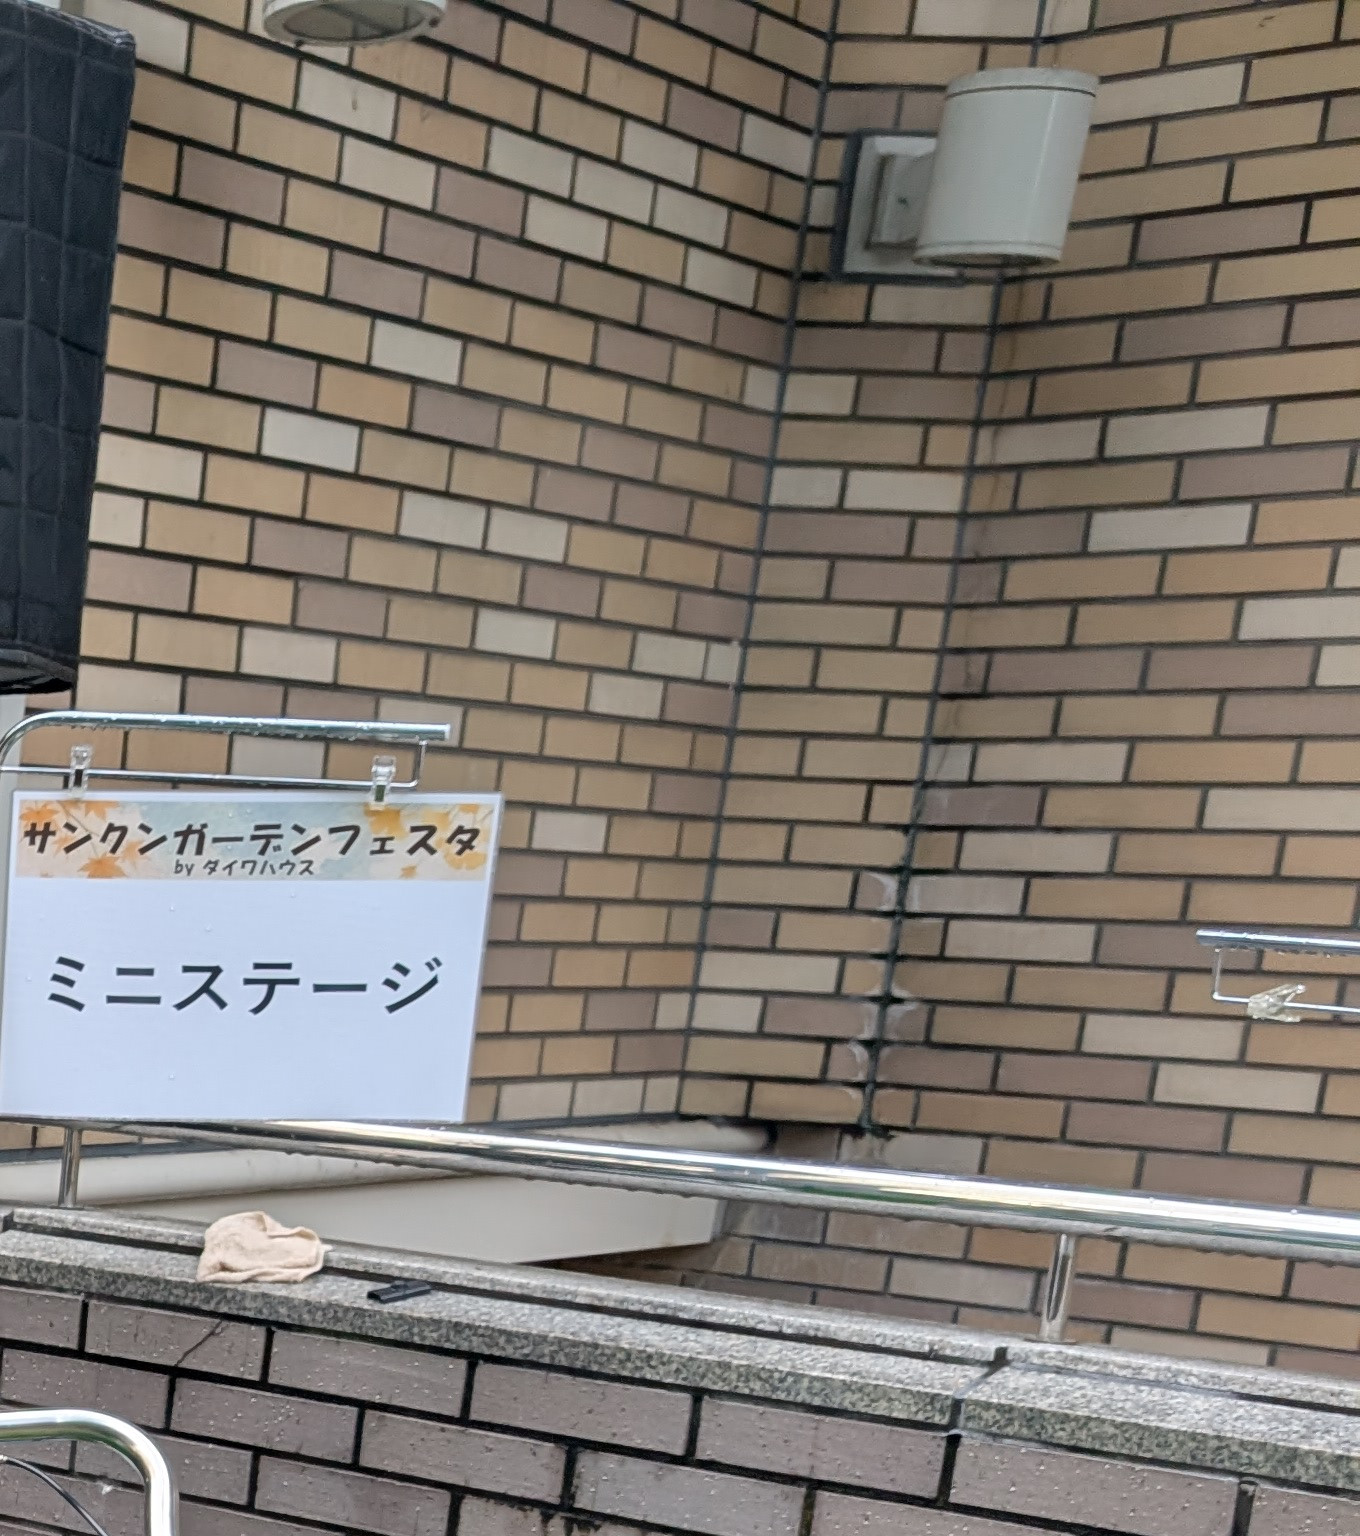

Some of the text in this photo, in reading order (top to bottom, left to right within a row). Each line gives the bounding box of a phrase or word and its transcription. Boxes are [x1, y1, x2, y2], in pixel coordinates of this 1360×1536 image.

[23, 821, 481, 857] サンクンガーデンフェスタ
[174, 859, 315, 877] by ダイワハウス
[48, 956, 444, 1015] ミニステージ
